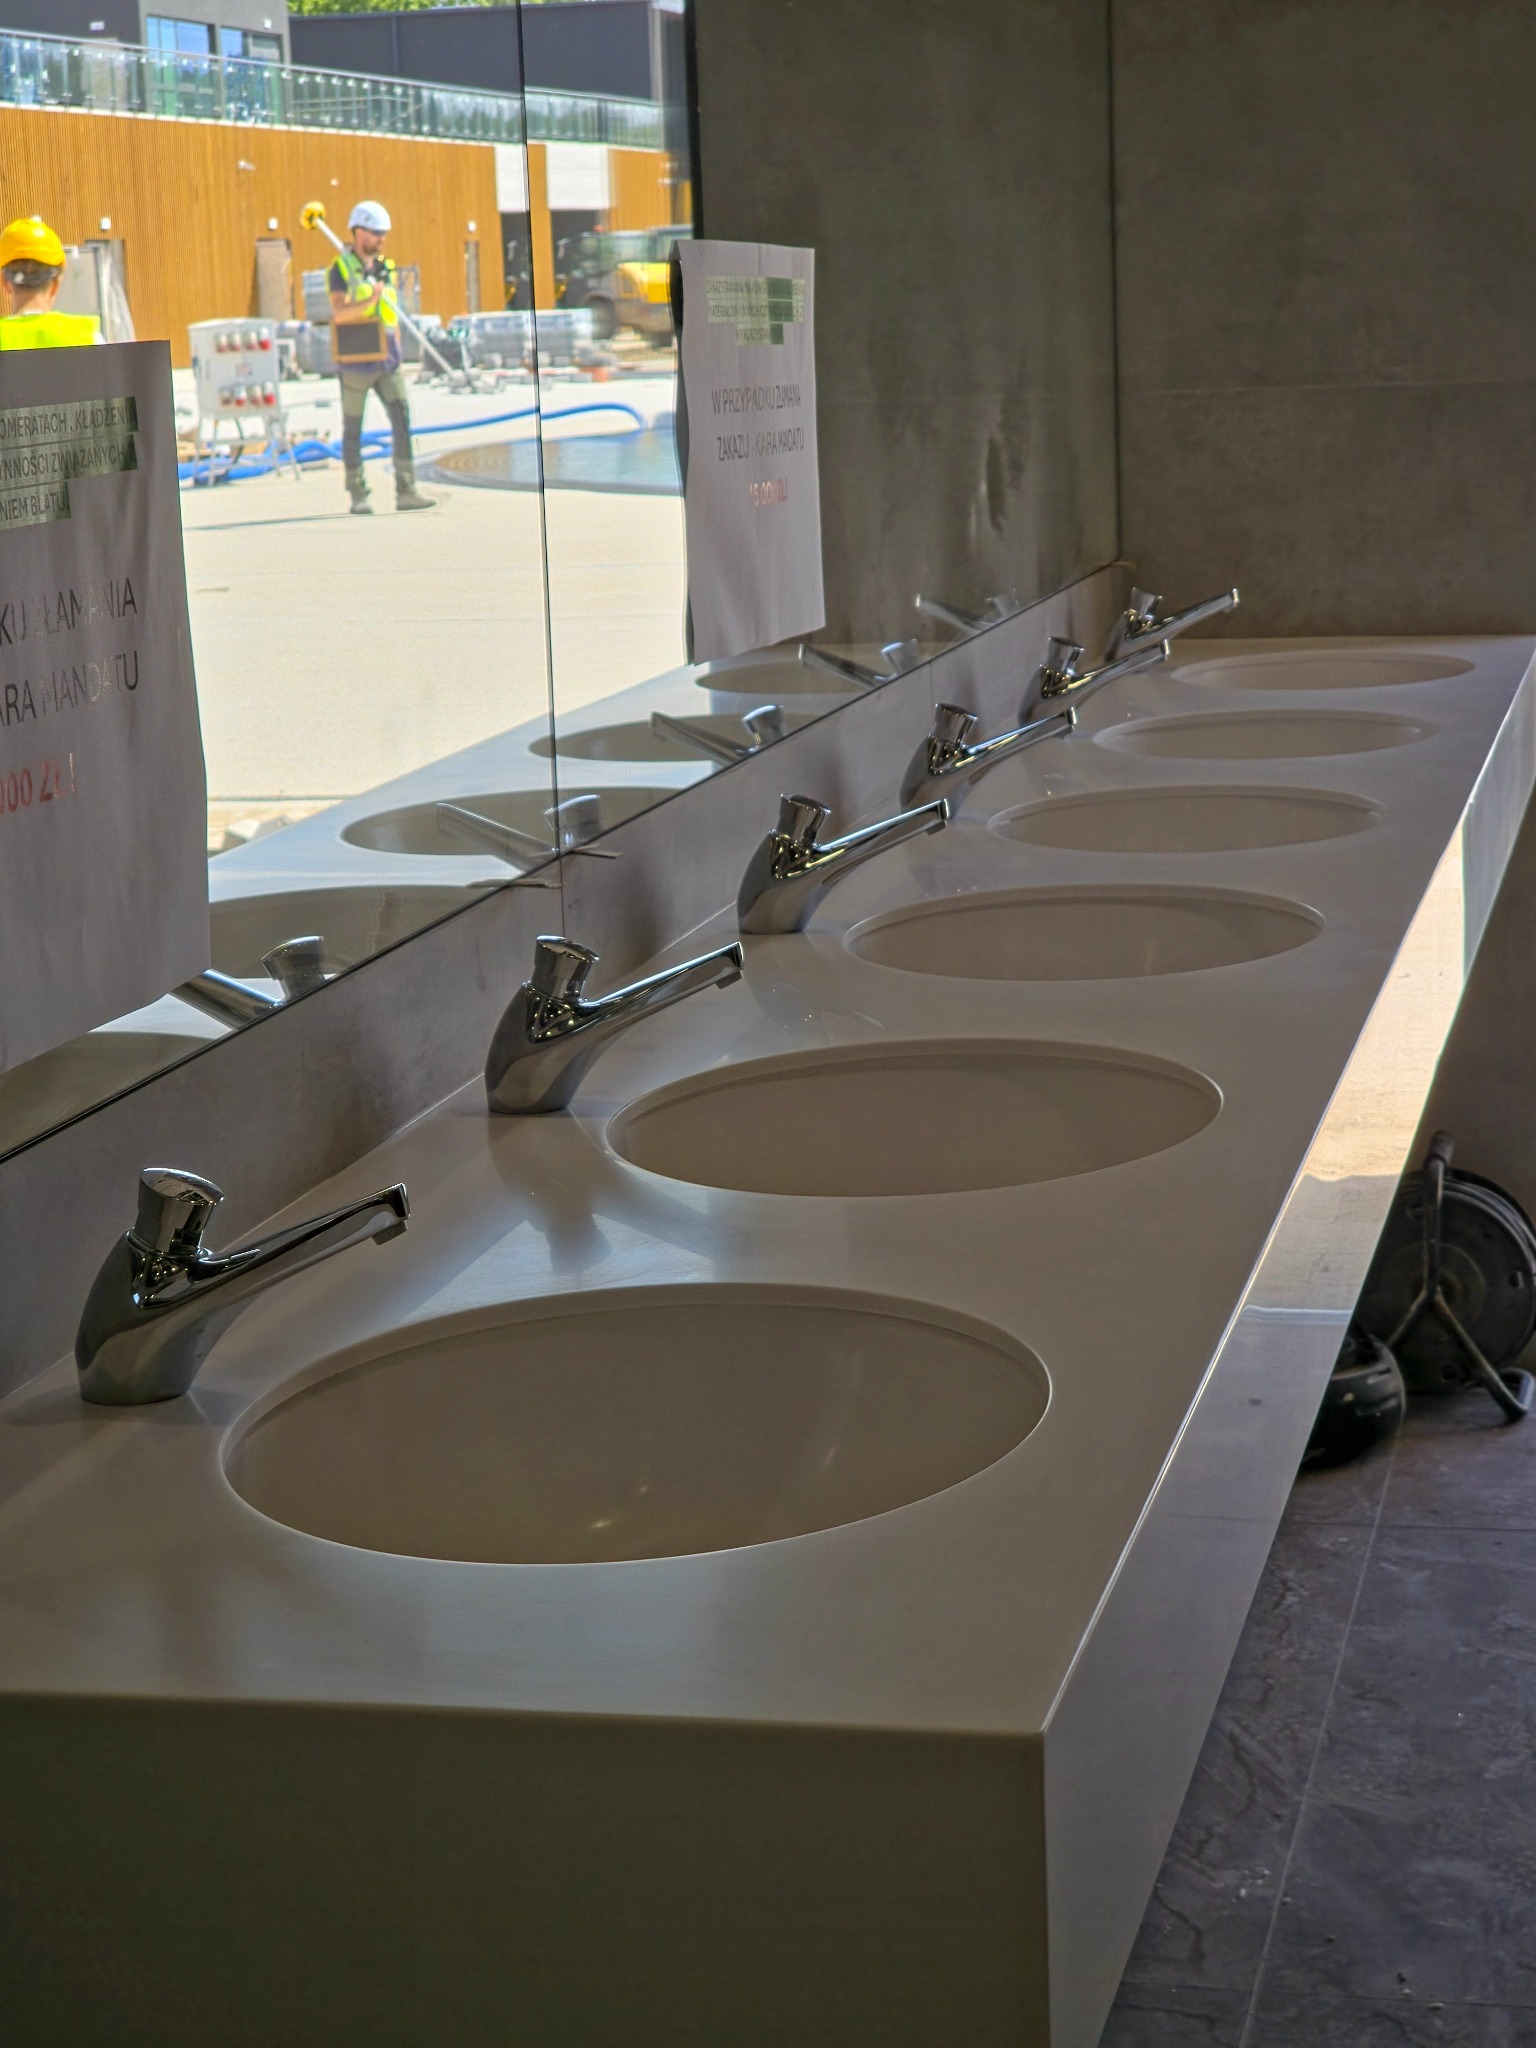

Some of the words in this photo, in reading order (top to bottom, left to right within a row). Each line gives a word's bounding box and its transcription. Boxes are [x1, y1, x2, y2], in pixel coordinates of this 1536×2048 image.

[711, 389, 721, 414] W
[722, 386, 775, 413] PRZYPADKU
[0, 412, 67, 440] OMERATACH
[716, 433, 750, 461] ZAKAZU
[756, 431, 778, 457] KARA
[0, 768, 32, 816] 00
